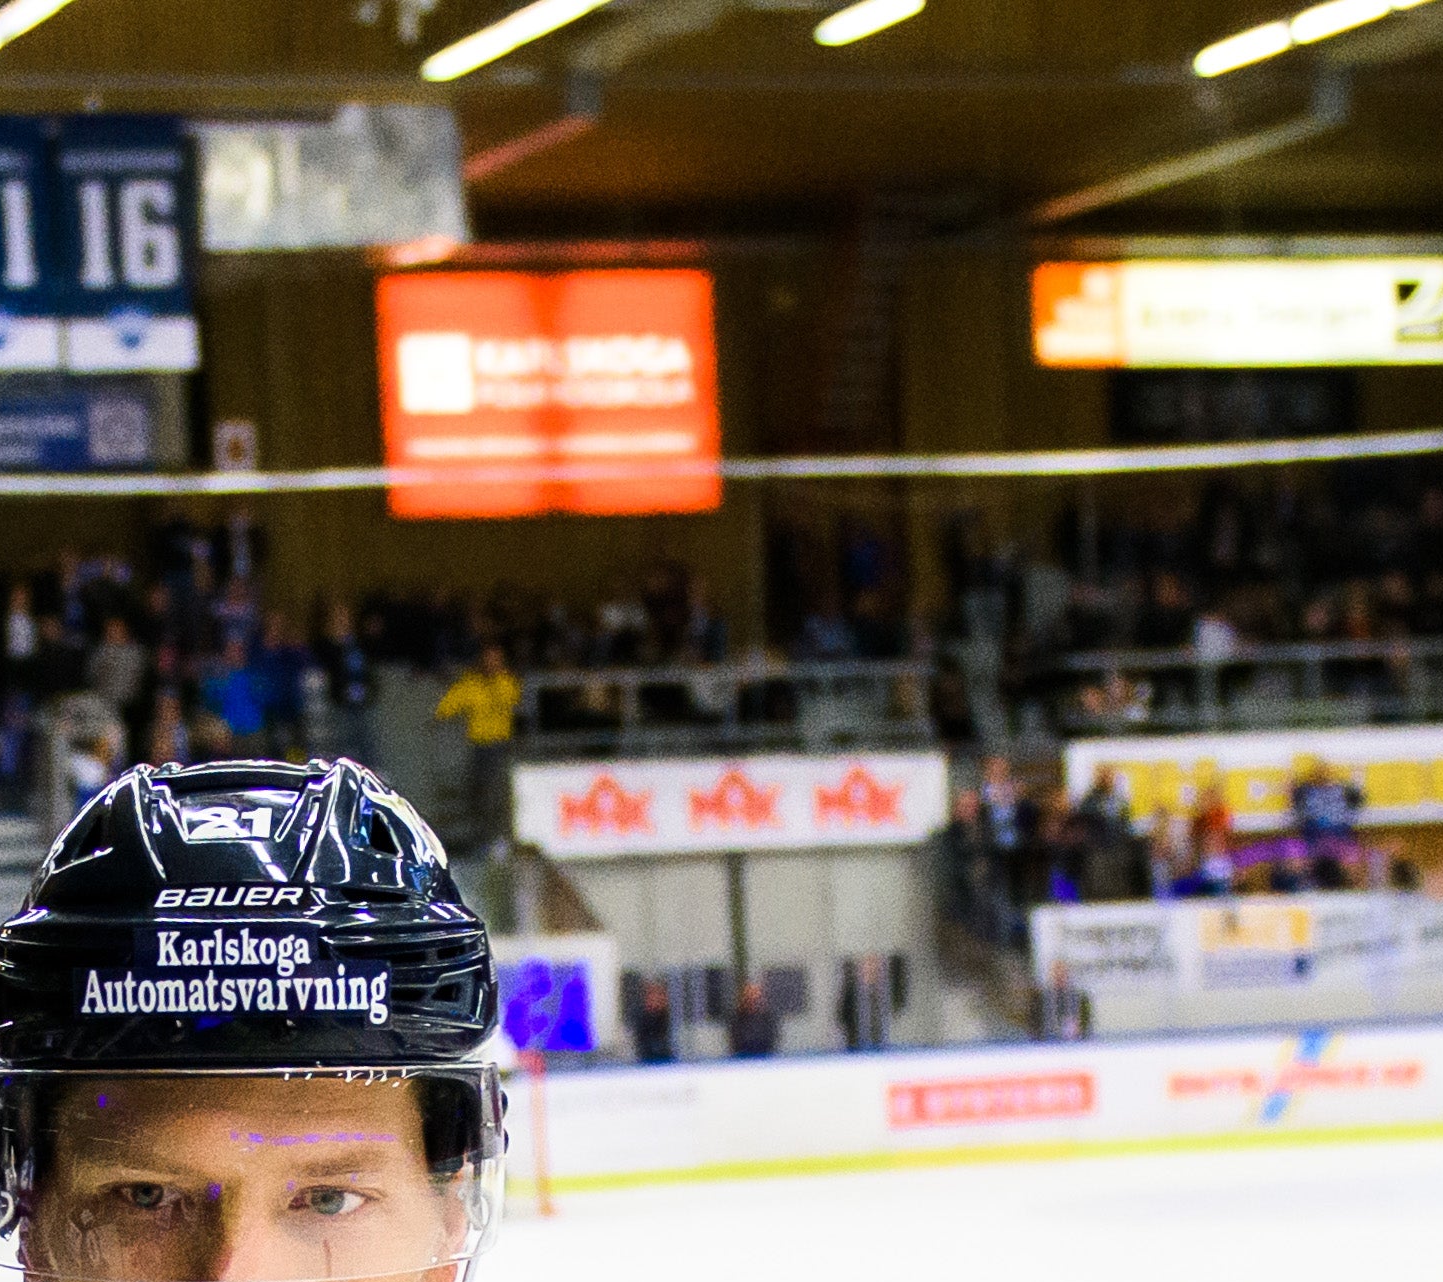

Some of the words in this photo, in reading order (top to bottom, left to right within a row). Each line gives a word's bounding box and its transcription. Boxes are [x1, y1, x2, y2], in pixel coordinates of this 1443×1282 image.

[76, 177, 184, 292] 16
[153, 886, 304, 909] BAUER
[156, 928, 312, 977] Karlskoga
[80, 963, 389, 1025] Automatsvarvning
